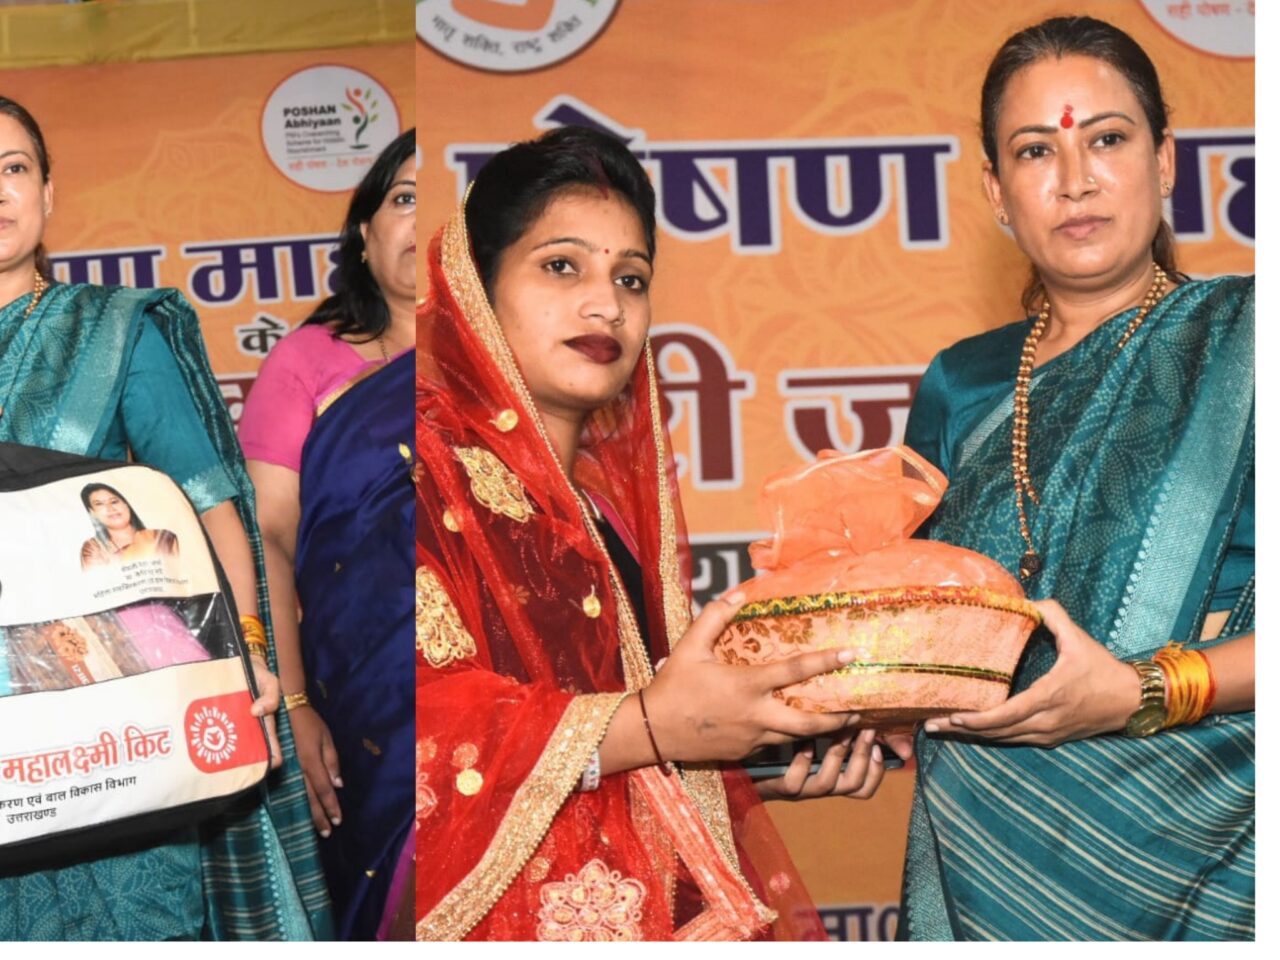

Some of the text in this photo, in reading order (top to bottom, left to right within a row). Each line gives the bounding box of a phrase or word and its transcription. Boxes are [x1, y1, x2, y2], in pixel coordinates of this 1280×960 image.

[283, 105, 336, 117] POSHAN
[284, 117, 341, 129] Abhiyaan
[239, 316, 285, 353] के
[1, 731, 118, 784] महालक्ष्मी
[123, 726, 171, 762] किट
[69, 781, 103, 800] विकास
[105, 775, 137, 792] विभाग
